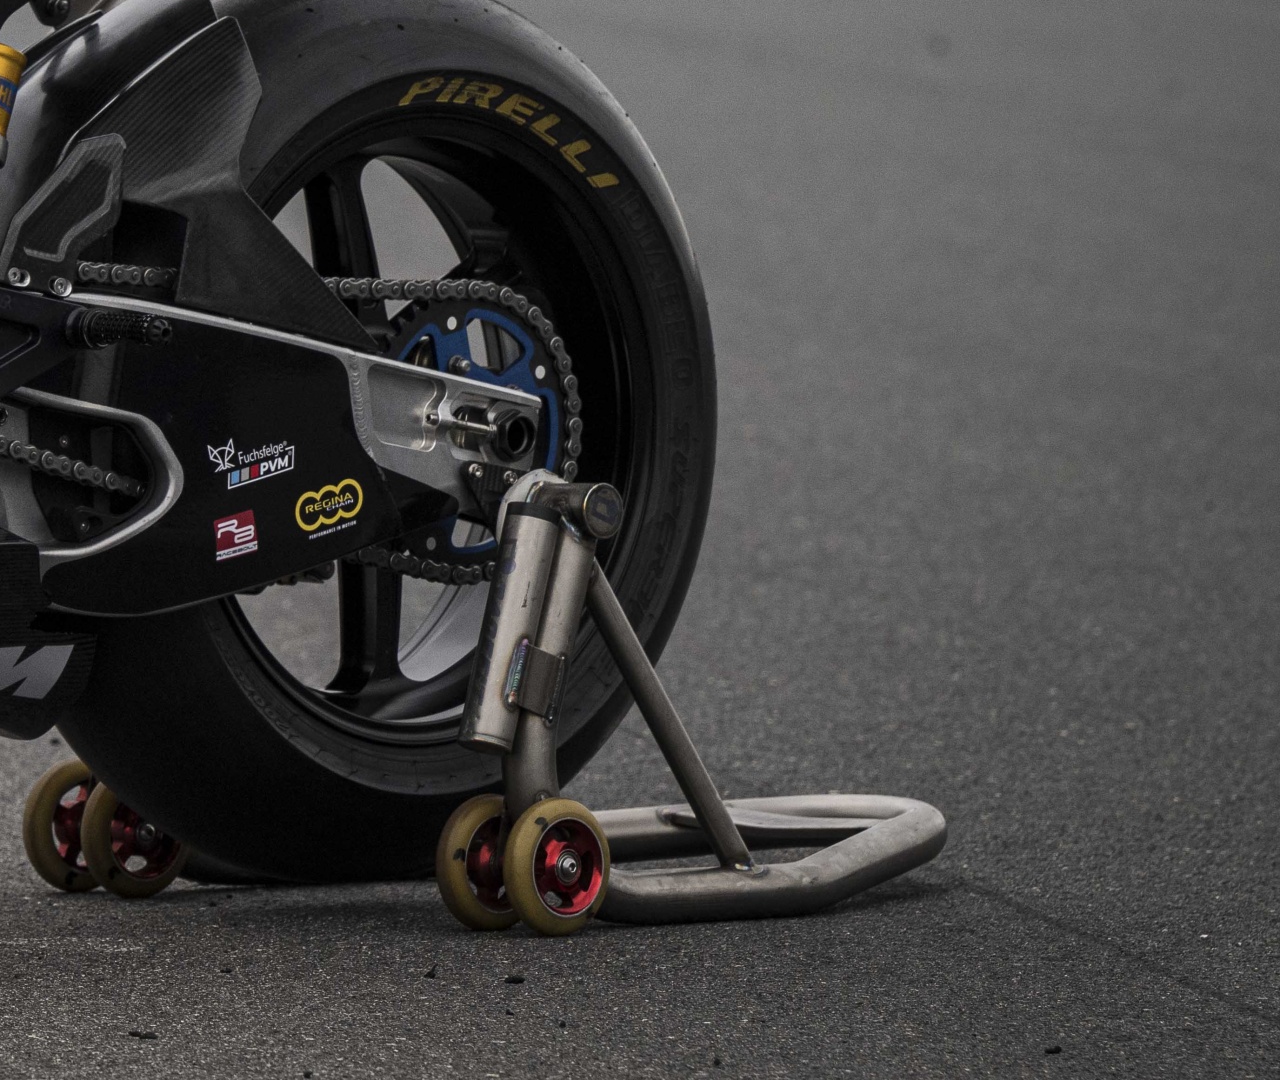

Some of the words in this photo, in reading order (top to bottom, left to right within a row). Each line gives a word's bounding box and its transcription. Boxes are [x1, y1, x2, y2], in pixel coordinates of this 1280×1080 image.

[398, 76, 620, 190] PIRELLI
[260, 455, 289, 475] PVM
[305, 492, 353, 514] REGINA
[326, 498, 354, 512] CHAIN
[309, 527, 336, 540] PERFORMANCE
[341, 520, 357, 530] MOTION
[216, 542, 258, 559] RACEBOLT
